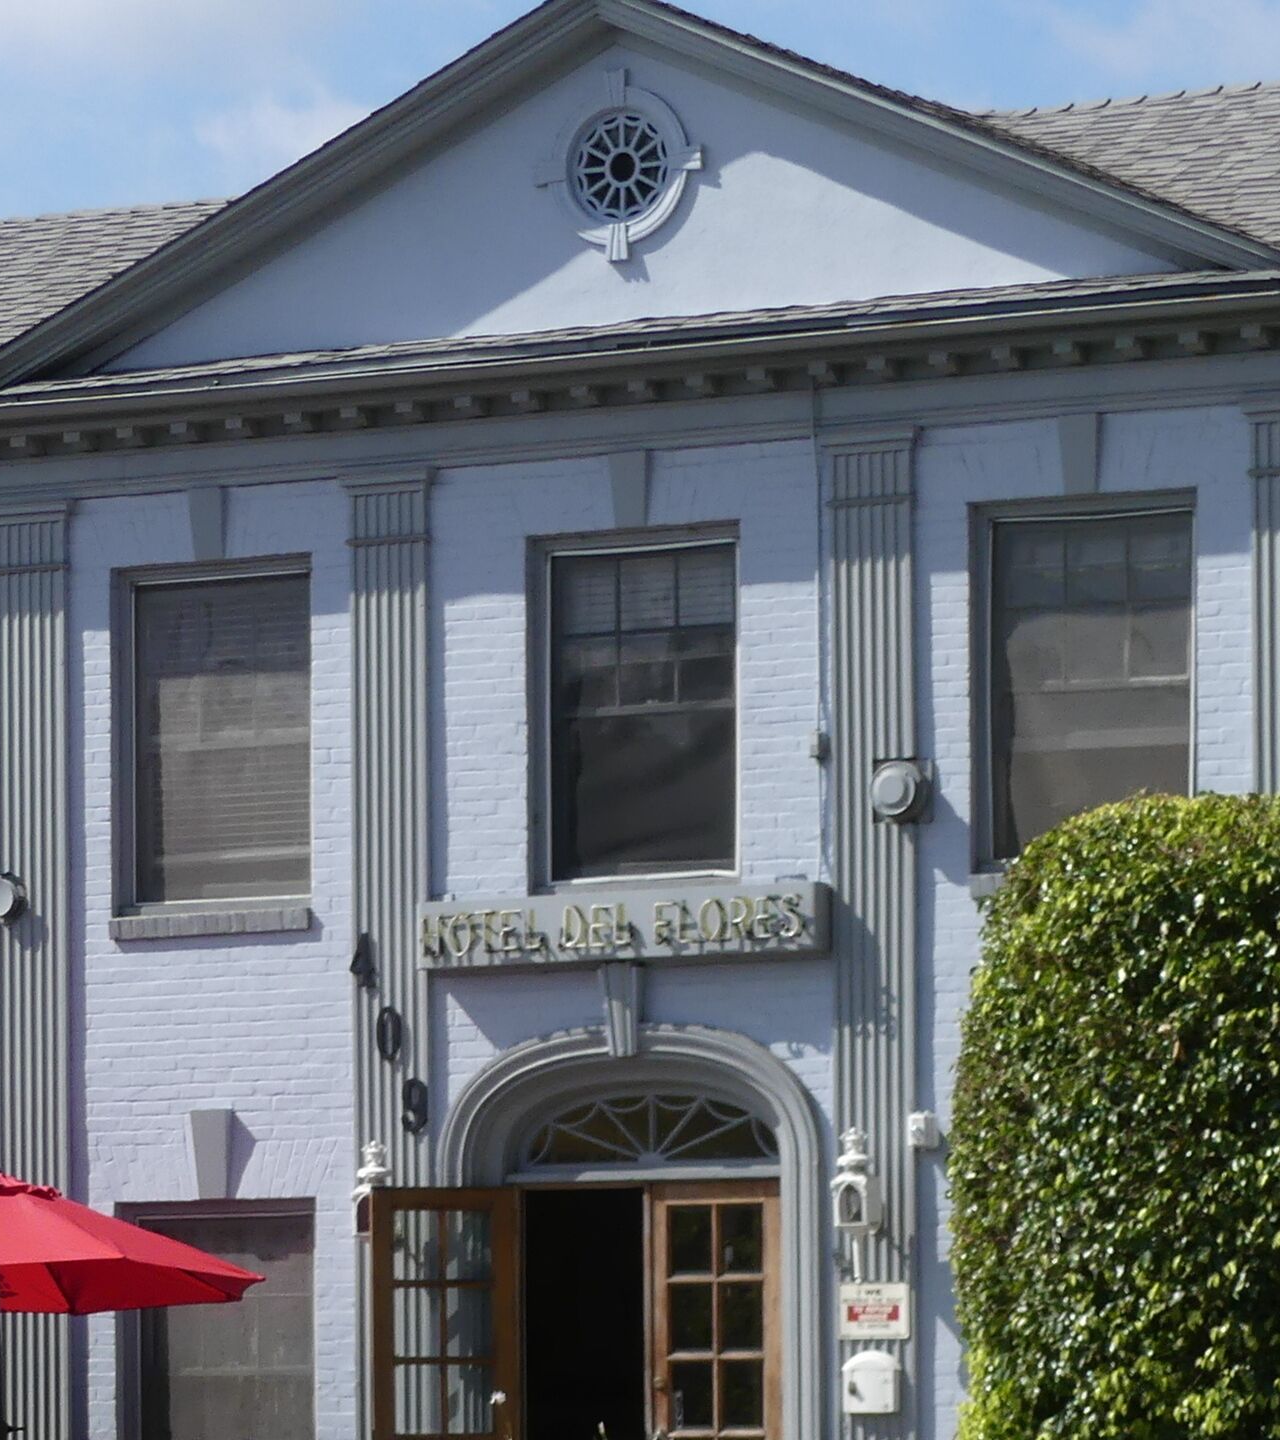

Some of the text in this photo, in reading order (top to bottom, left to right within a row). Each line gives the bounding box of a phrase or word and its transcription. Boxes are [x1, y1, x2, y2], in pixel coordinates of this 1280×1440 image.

[422, 894, 805, 957] HOTEL DEL FLORES
